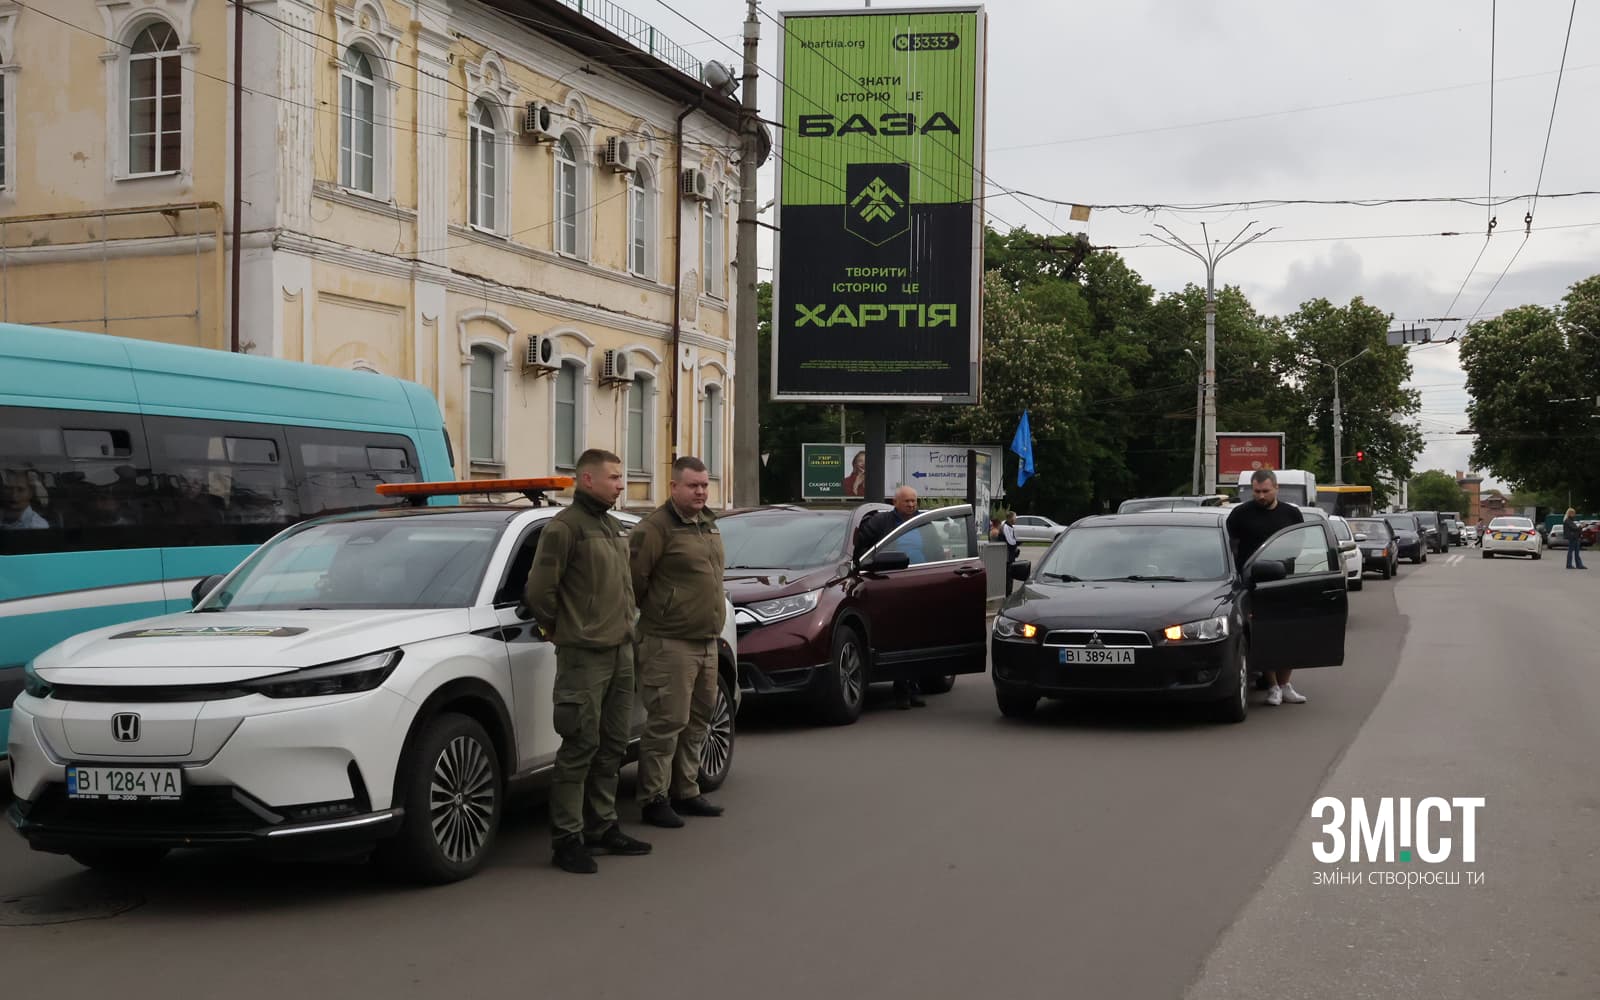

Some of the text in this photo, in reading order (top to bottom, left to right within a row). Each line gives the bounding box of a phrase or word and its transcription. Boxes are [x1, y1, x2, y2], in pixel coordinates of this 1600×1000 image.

[800, 38, 865, 49] khartiia.org
[858, 76, 901, 87] ЗНАТИ
[906, 91, 924, 102] ЦЕ
[798, 112, 960, 137] БАЗА
[845, 267, 907, 278] ТВОРИТИ
[832, 283, 920, 294] ІСТОРІЮ ЦЕ
[794, 303, 957, 328] ХАРТІЯ
[1085, 651, 1113, 662] 3894
[77, 770, 176, 793] BI 1284 YA
